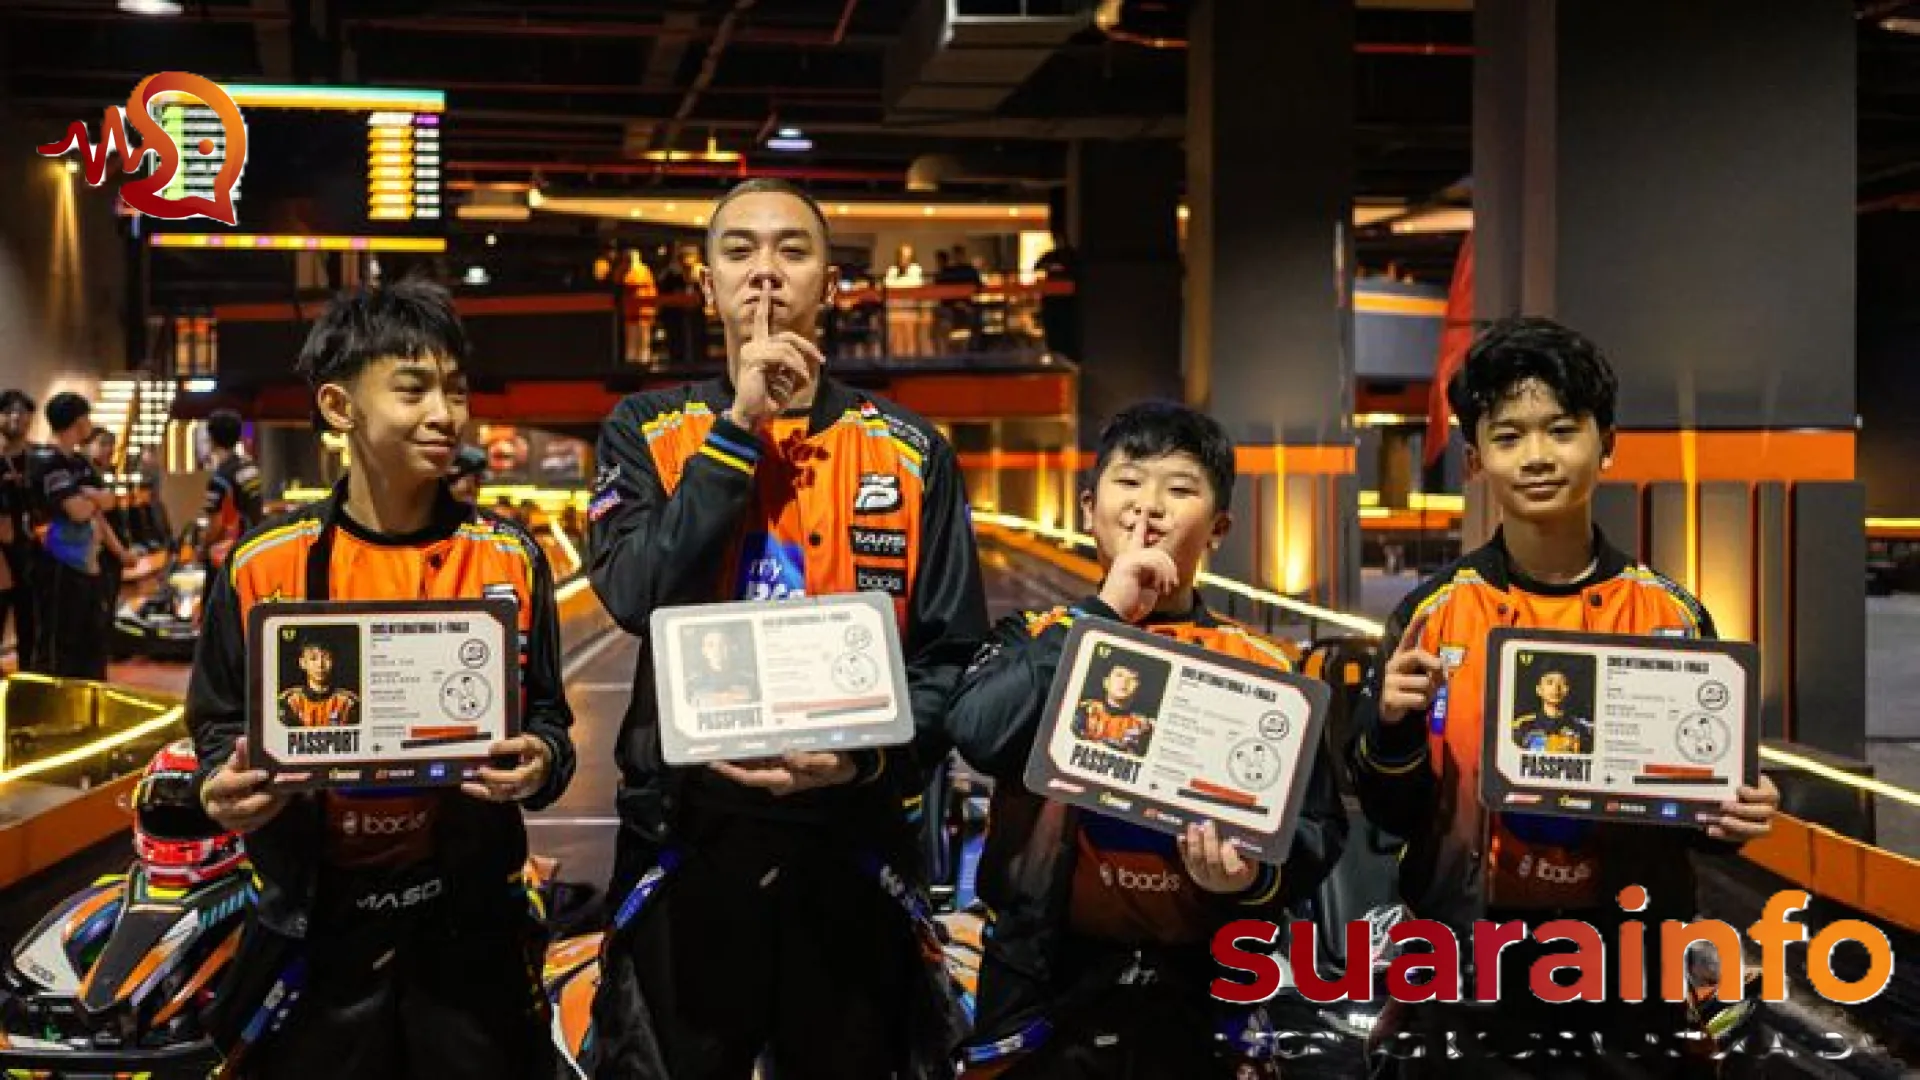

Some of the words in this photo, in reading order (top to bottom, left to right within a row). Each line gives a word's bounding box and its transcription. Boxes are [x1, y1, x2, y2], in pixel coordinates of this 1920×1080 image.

[287, 730, 361, 756] PASSPORT
[1069, 743, 1142, 785] PASSPORT
[1519, 753, 1594, 783] PASSPORT
